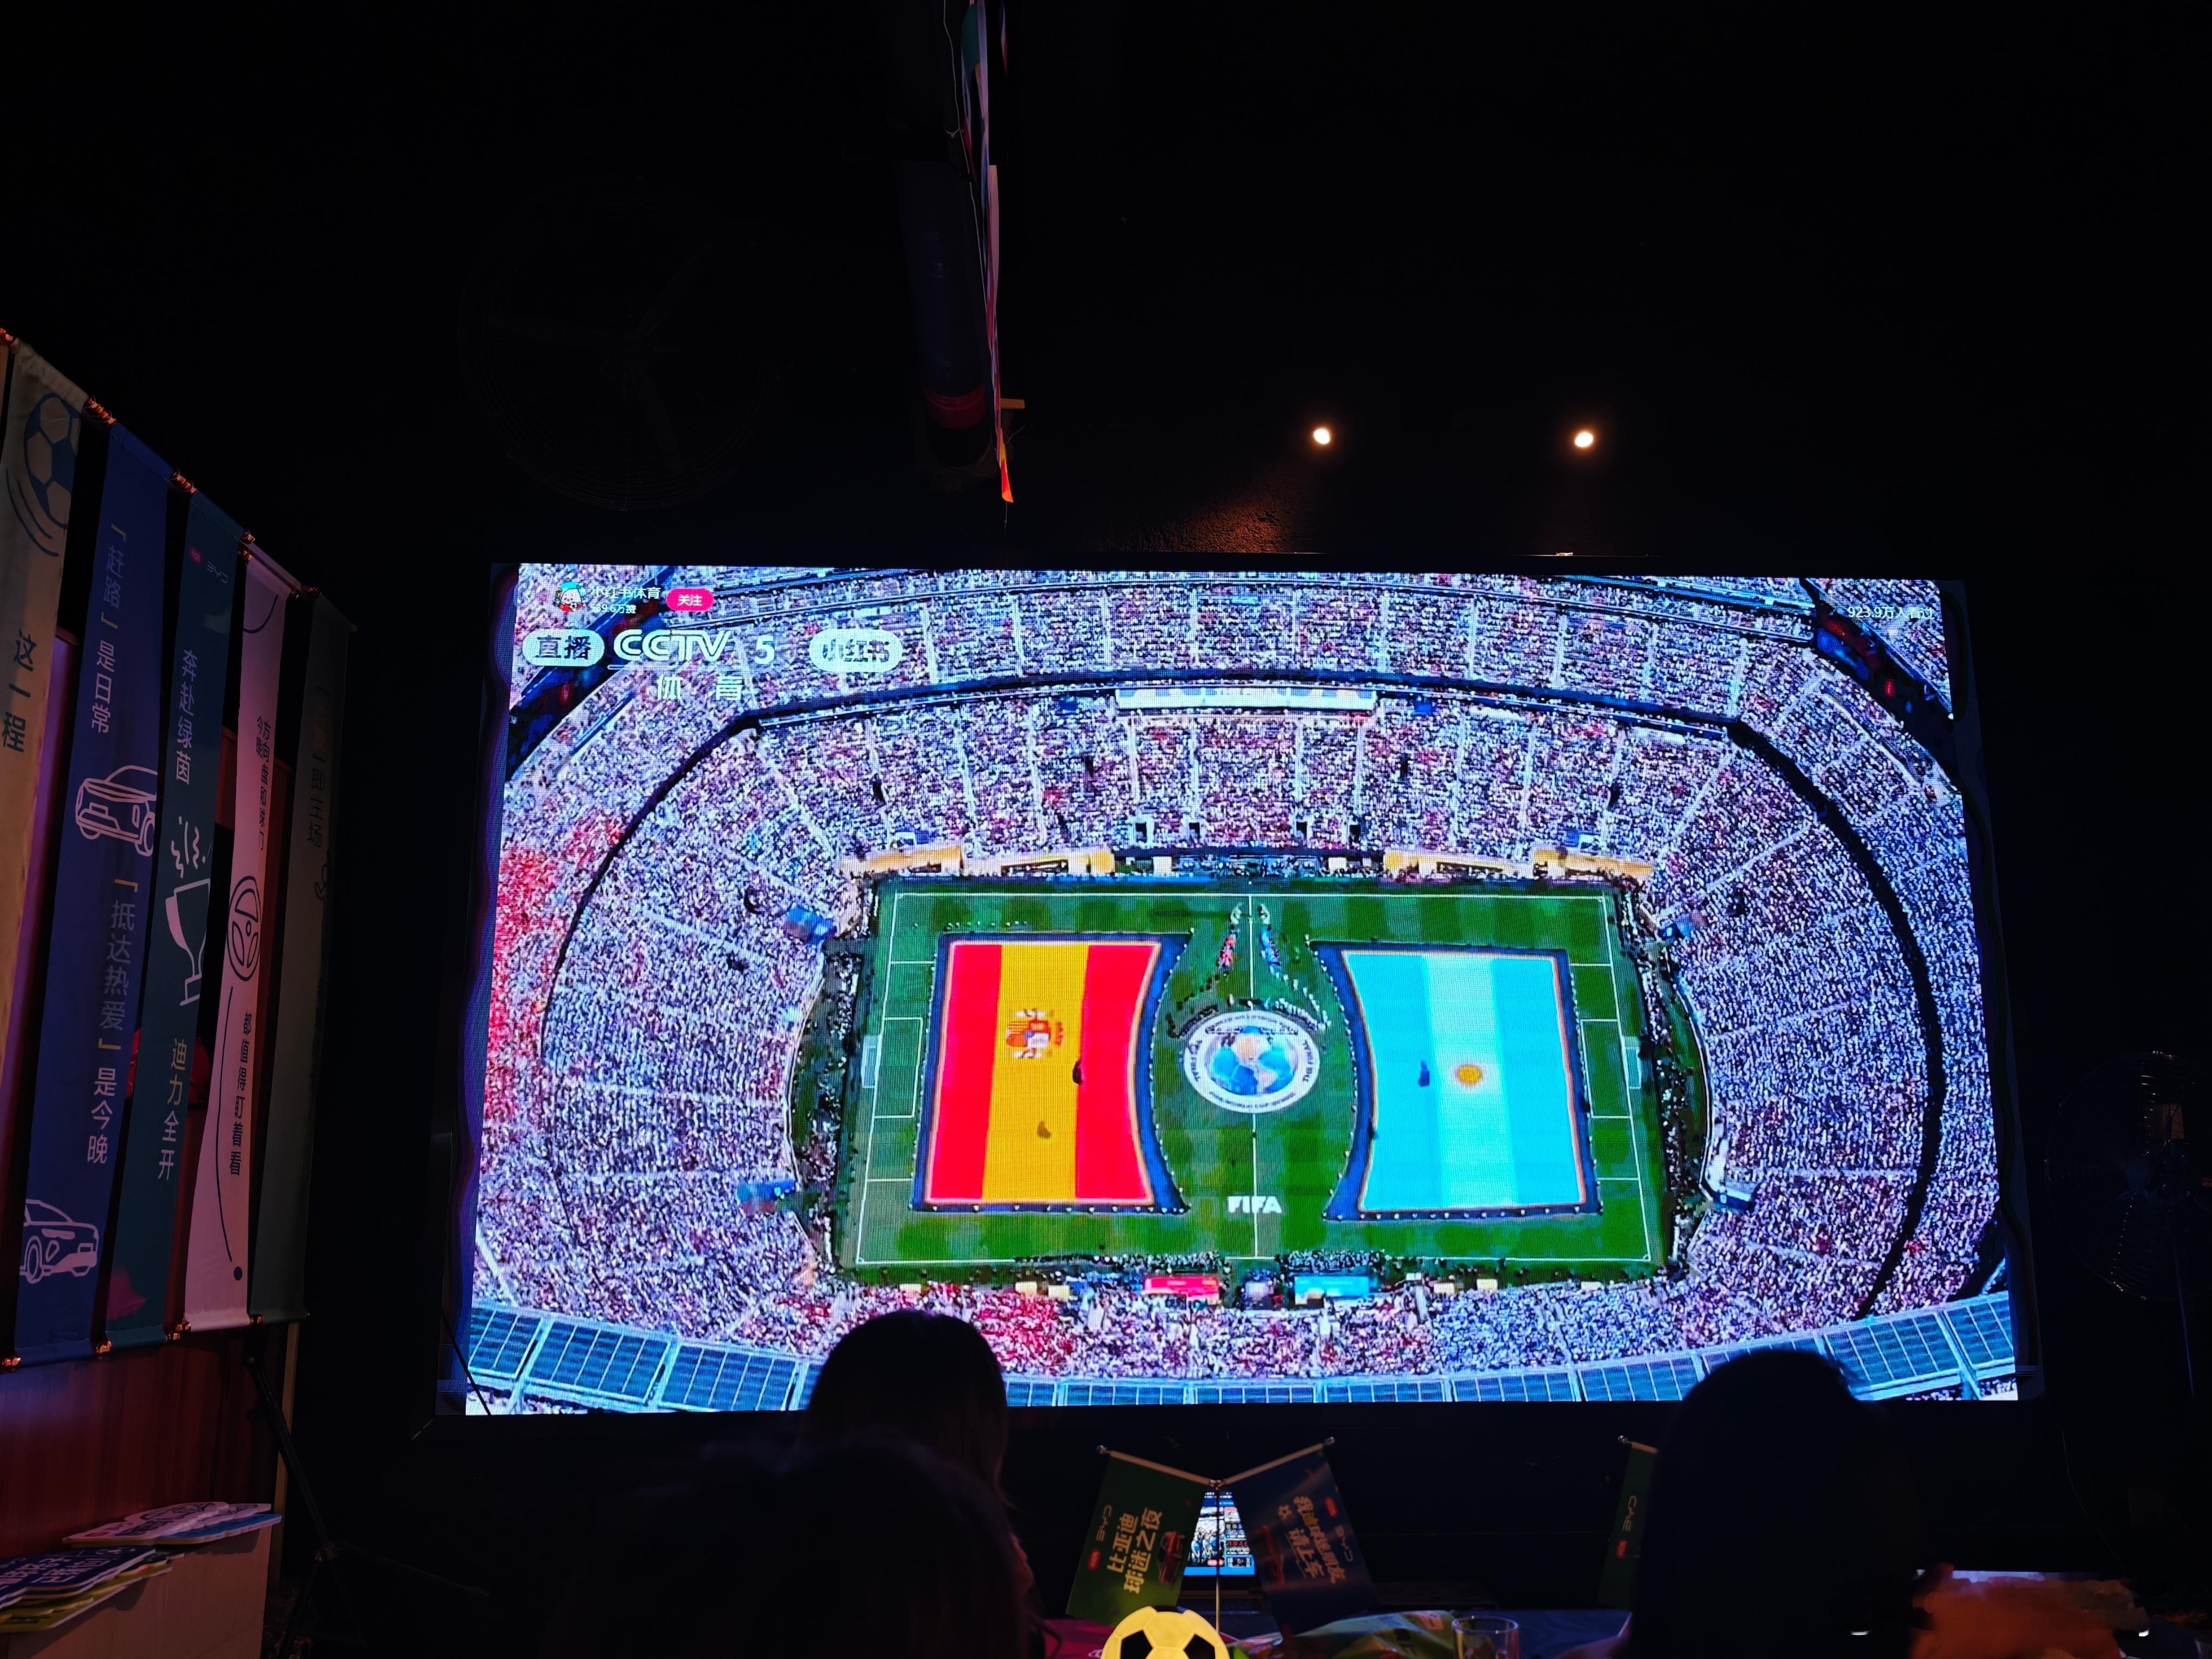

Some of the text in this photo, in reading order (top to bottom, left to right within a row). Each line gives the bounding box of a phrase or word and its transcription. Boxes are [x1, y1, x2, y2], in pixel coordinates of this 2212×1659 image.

[590, 586, 662, 600] 小红书体育
[677, 594, 704, 606] 关注
[1847, 606, 1936, 619] 923.9万人看过
[536, 635, 593, 660] 直播
[613, 628, 776, 663] CCTV 5
[822, 638, 891, 664] 小红书
[2, 629, 37, 753] 这一程
[656, 676, 745, 701] 体育
[176, 649, 199, 785] 奔赴绿茵
[86, 877, 138, 1164] 「抵达热爱」是今晚
[157, 1037, 188, 1181] 迪力全开
[230, 1011, 252, 1176] 都值得盯着看
[1226, 1195, 1282, 1213] FIFA
[1095, 1503, 1114, 1542] BYD
[1106, 1512, 1139, 1574] 比亚迪
[1123, 1507, 1163, 1595] 球迷之夜
[1334, 1524, 1354, 1563] BYD
